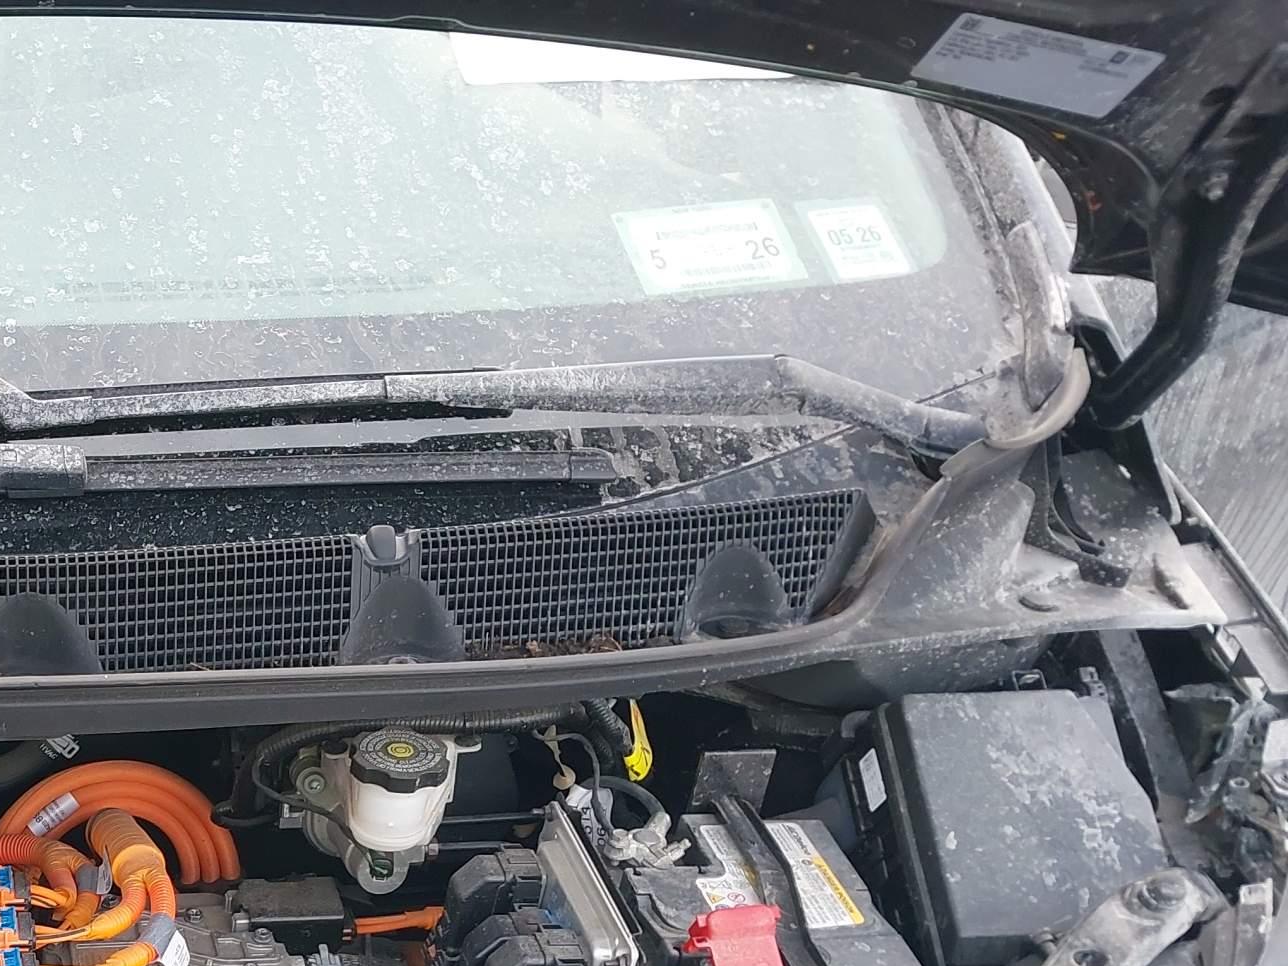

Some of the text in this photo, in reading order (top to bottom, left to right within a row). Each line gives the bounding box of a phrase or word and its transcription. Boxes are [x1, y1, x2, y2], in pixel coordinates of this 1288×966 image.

[827, 225, 882, 246] 05 26
[649, 248, 667, 270] 5
[744, 236, 780, 260] 26
